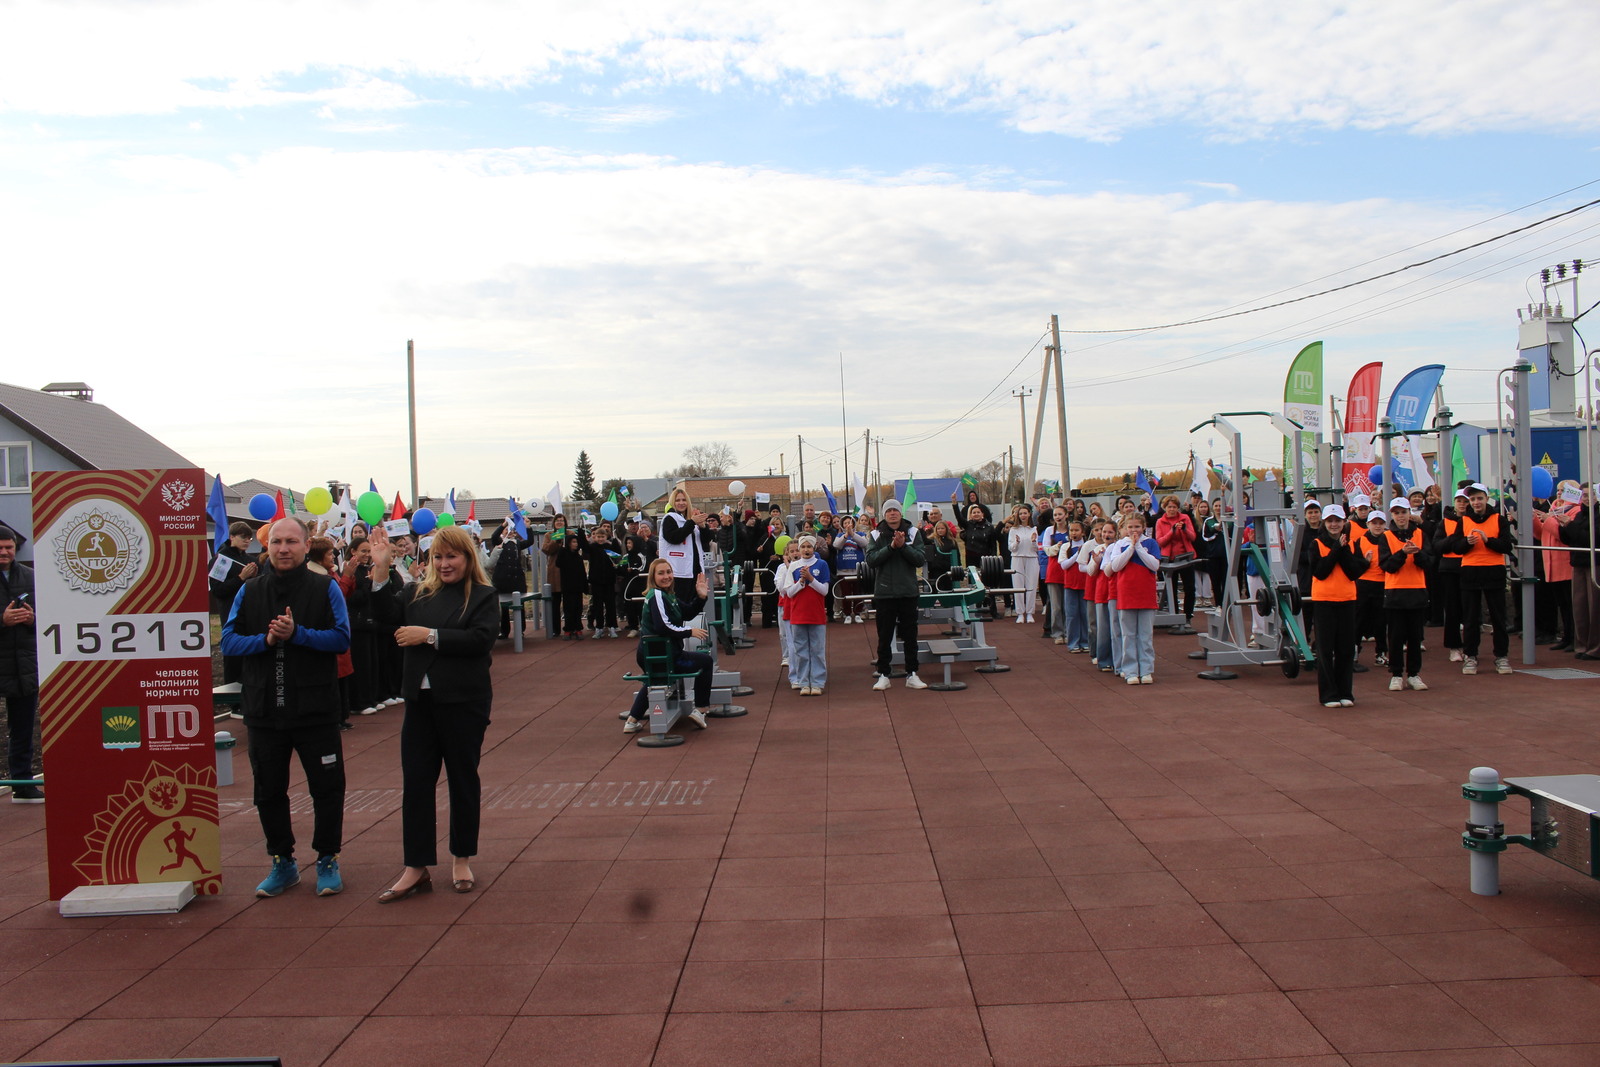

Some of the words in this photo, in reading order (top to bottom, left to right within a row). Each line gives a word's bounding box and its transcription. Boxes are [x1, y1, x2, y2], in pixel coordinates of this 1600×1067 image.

[87, 558, 109, 568] ГТО
[43, 619, 206, 655] 15213
[155, 669, 200, 678] человек
[276, 661, 285, 685] FOCUS
[140, 679, 200, 688] выполнили
[145, 689, 180, 699] нормы
[276, 685, 285, 695] ON
[276, 696, 285, 707] ME
[147, 704, 200, 739] ГТО
